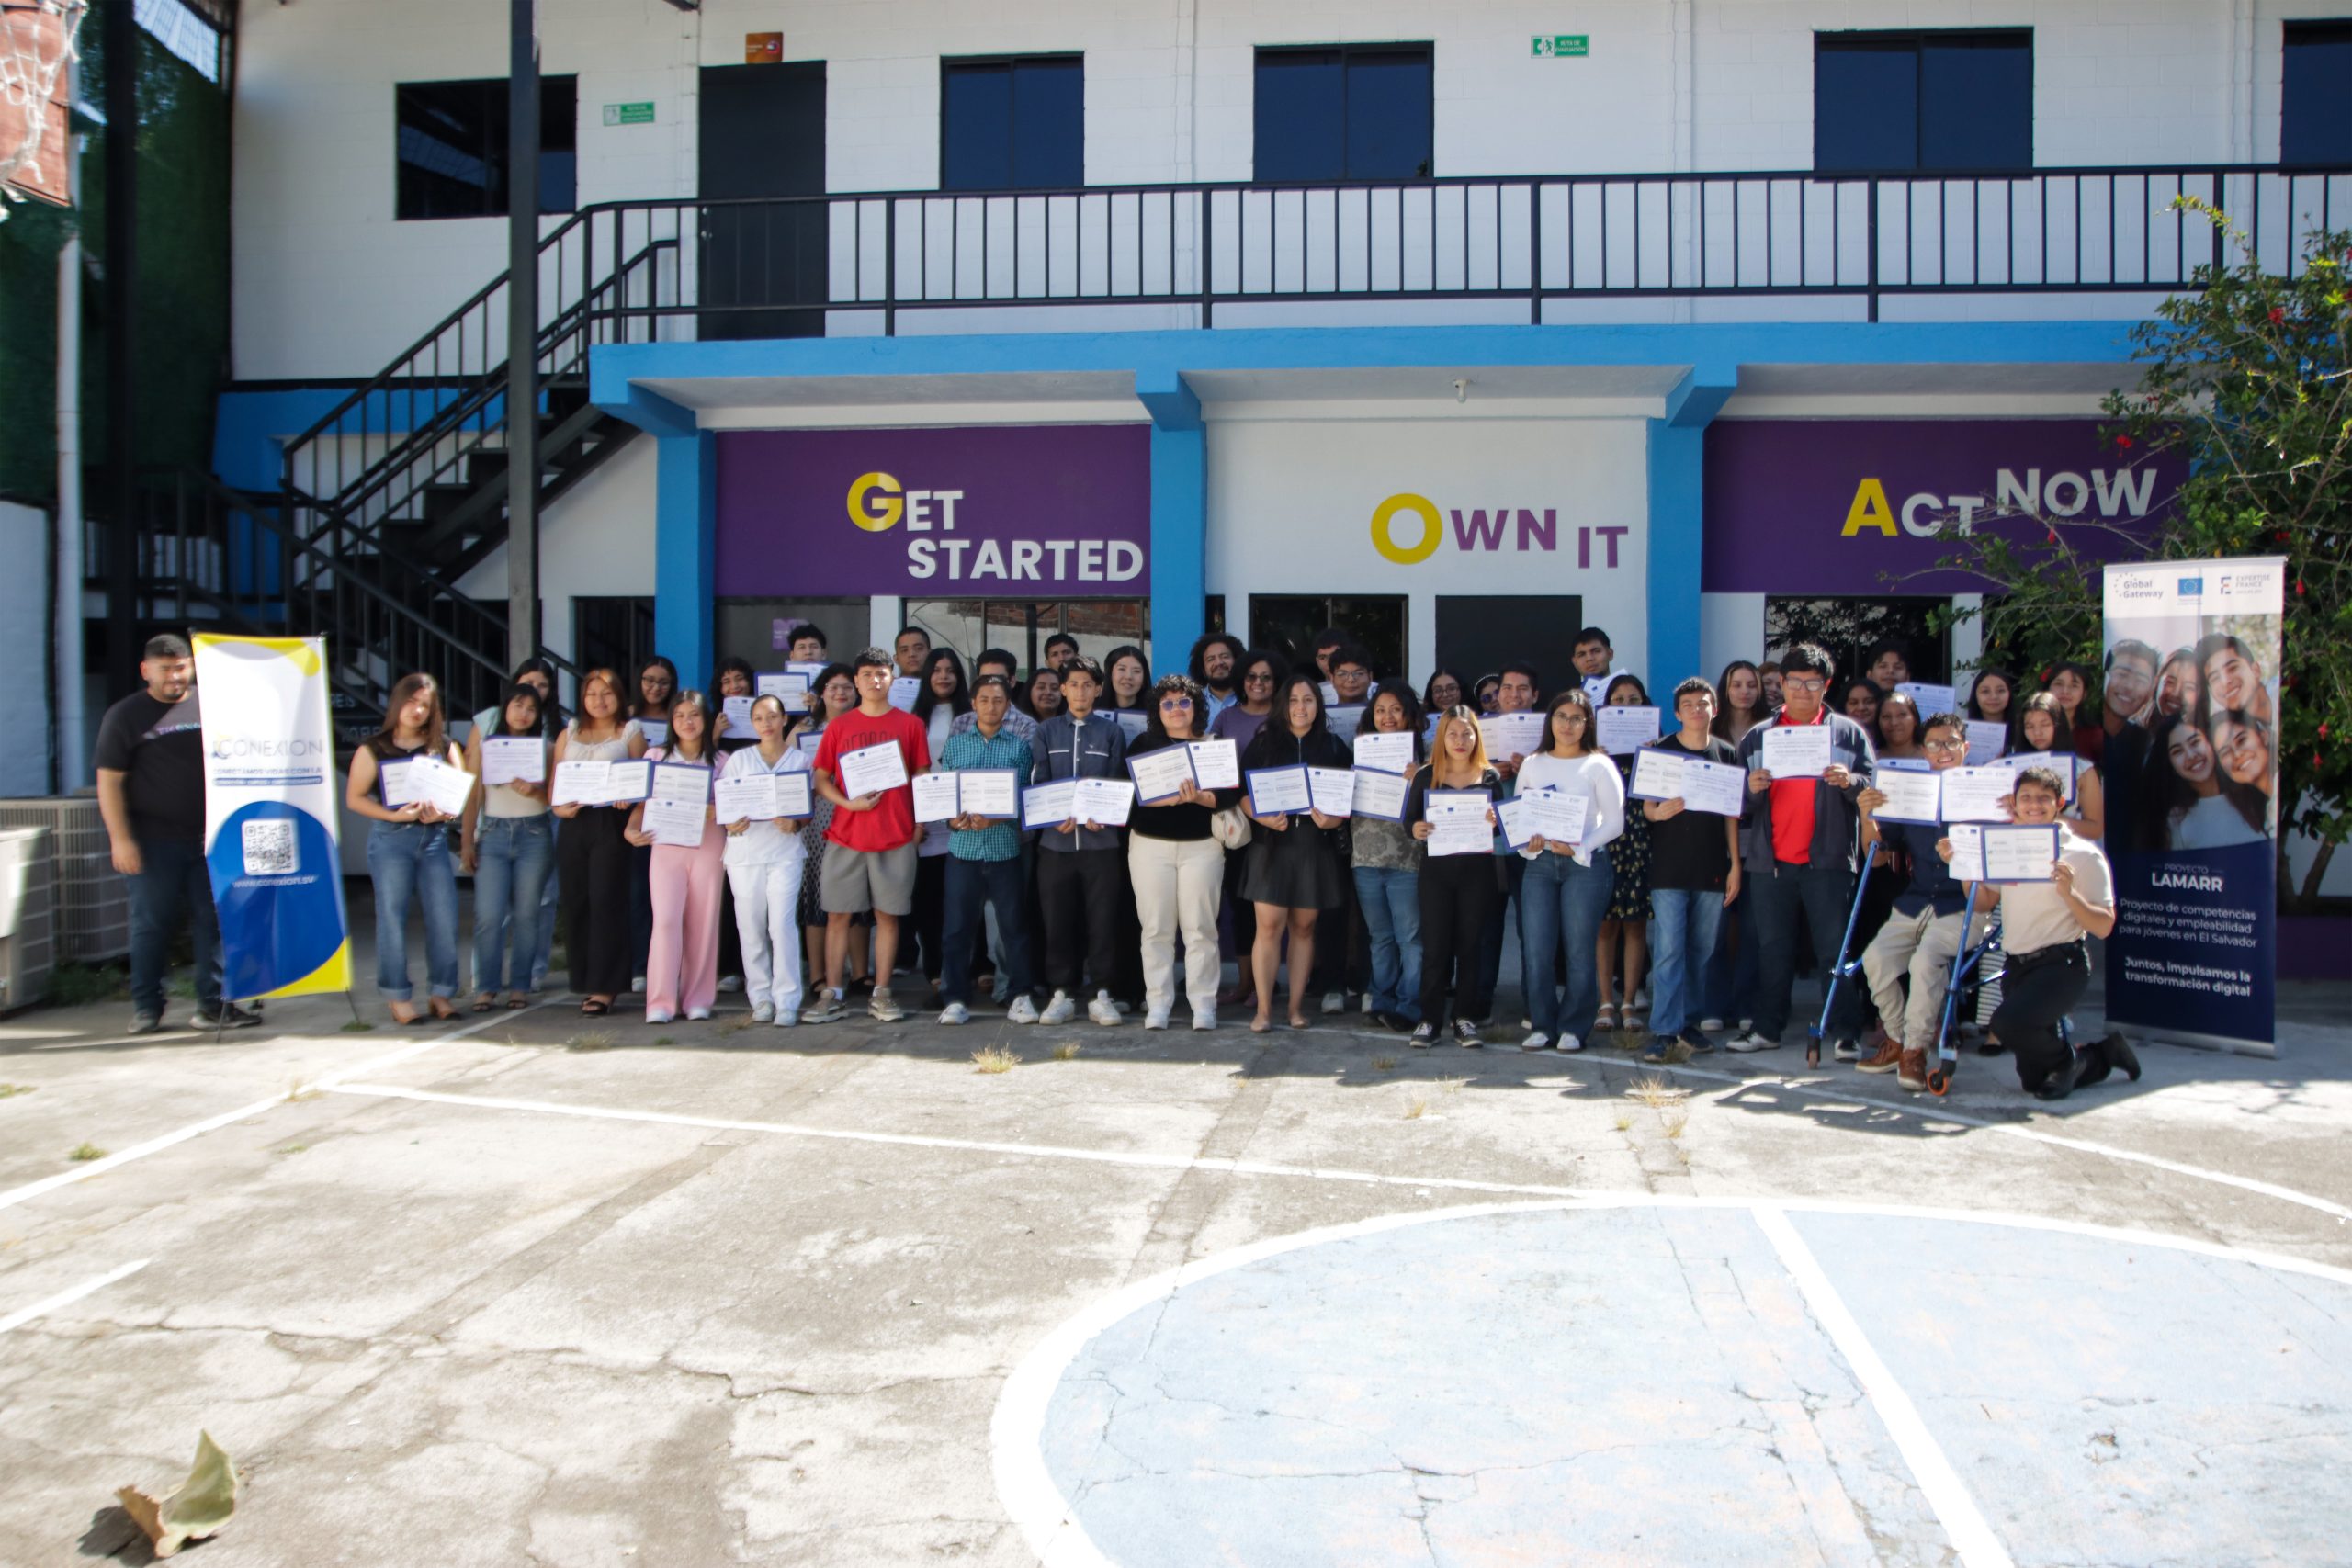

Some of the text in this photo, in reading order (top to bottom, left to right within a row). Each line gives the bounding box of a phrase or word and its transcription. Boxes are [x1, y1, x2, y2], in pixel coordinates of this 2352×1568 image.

[846, 471, 963, 532] GET
[1840, 468, 2158, 537] ACT NOW
[1370, 492, 1629, 569] OWN IT
[907, 538, 1144, 581] STARTED
[2123, 580, 2153, 590] Global
[2123, 590, 2164, 600] Gateway
[2164, 863, 2209, 874] PROYECTO
[2151, 872, 2223, 892] LAMARR
[2120, 897, 2256, 921] Proyecto de competencias
[2123, 911, 2252, 934] digitales y empleabilidad
[2119, 925, 2257, 949] para jóvenes en El Salvador
[2124, 955, 2251, 983] Juntos, impulsamos la
[2124, 970, 2251, 998] transformación digital
